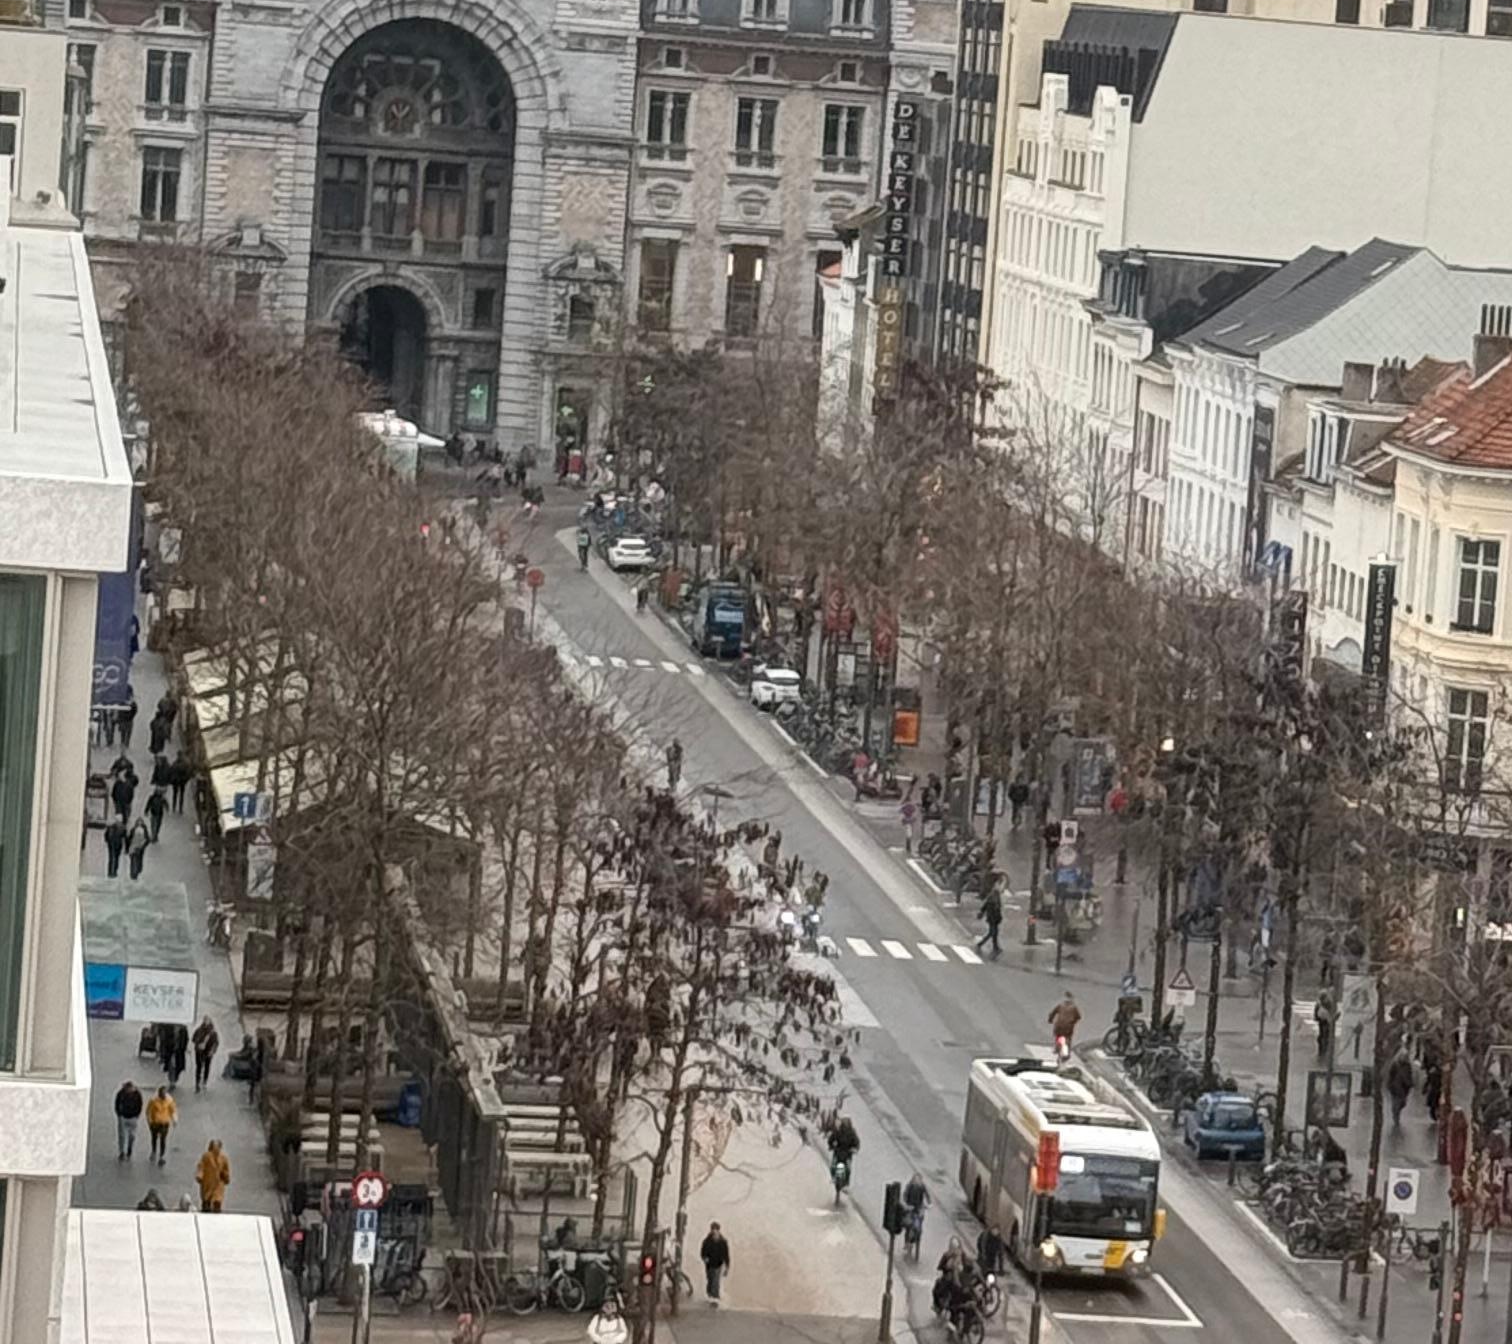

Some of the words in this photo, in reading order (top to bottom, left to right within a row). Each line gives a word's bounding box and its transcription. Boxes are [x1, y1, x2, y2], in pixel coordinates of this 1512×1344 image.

[898, 104, 914, 140] DE
[888, 154, 909, 274] KEYSER
[880, 287, 899, 387] HOTEL
[132, 983, 185, 996] KEYSER
